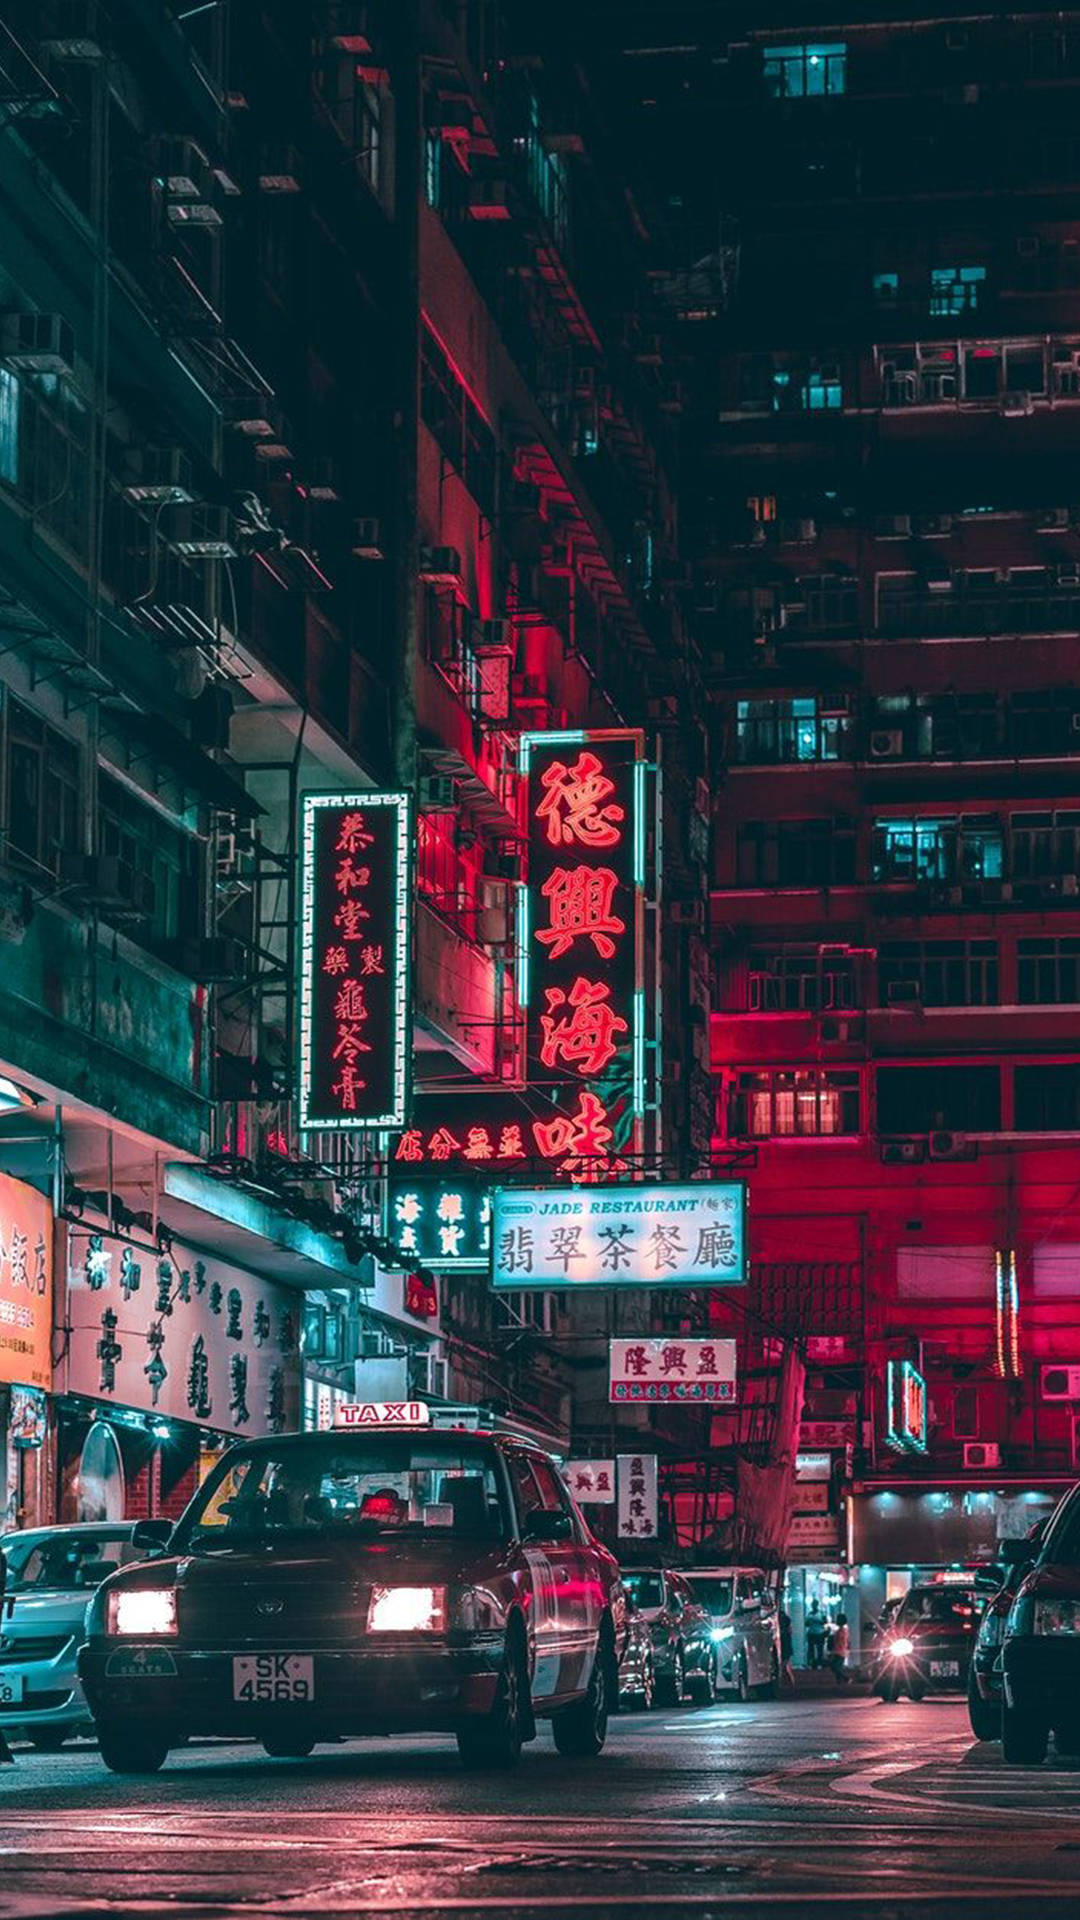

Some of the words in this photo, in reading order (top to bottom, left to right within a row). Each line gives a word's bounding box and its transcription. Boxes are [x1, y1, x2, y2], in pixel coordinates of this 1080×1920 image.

[539, 1203, 583, 1215] JADE
[590, 1200, 699, 1214] RESTAURANT
[499, 1220, 739, 1274] 翡翠茶餐廳
[341, 1403, 420, 1423] TAXI
[132, 1652, 145, 1665] 4
[255, 1656, 289, 1678] SK
[120, 1666, 162, 1674] SEATS
[239, 1679, 310, 1701] 4569
